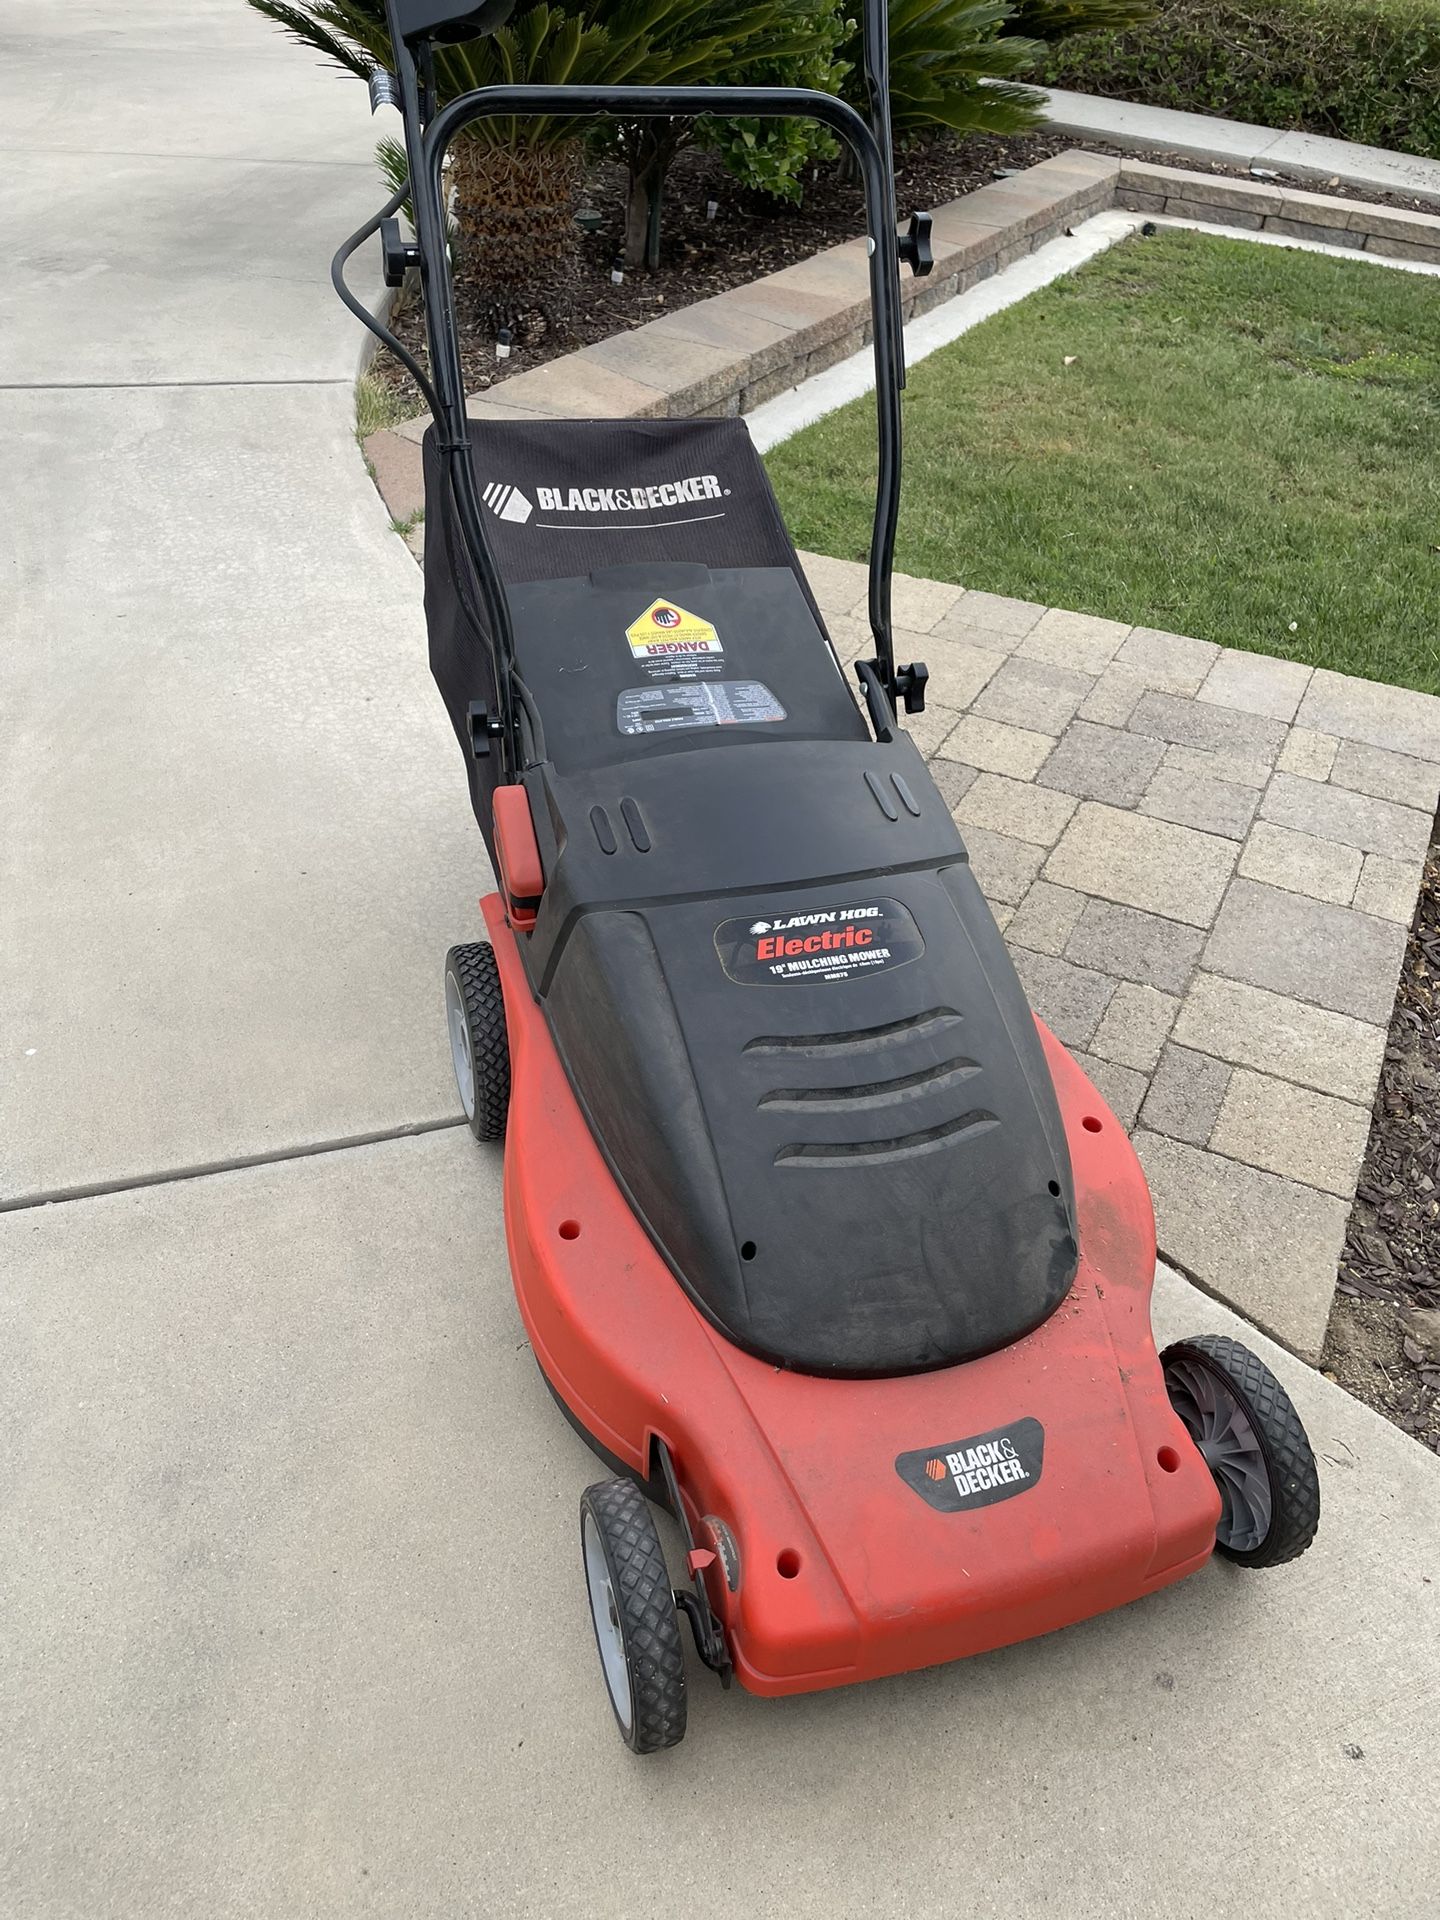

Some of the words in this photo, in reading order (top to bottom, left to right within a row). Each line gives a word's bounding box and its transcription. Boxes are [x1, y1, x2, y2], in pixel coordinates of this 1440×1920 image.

[646, 641, 710, 654] DANGER
[773, 912, 835, 930] LAWN
[757, 925, 873, 960] Electric
[787, 955, 848, 971] MULCHING
[848, 948, 891, 963] MOWER
[946, 1438, 1019, 1475] BLACK&
[953, 1458, 1025, 1497] DECKER
